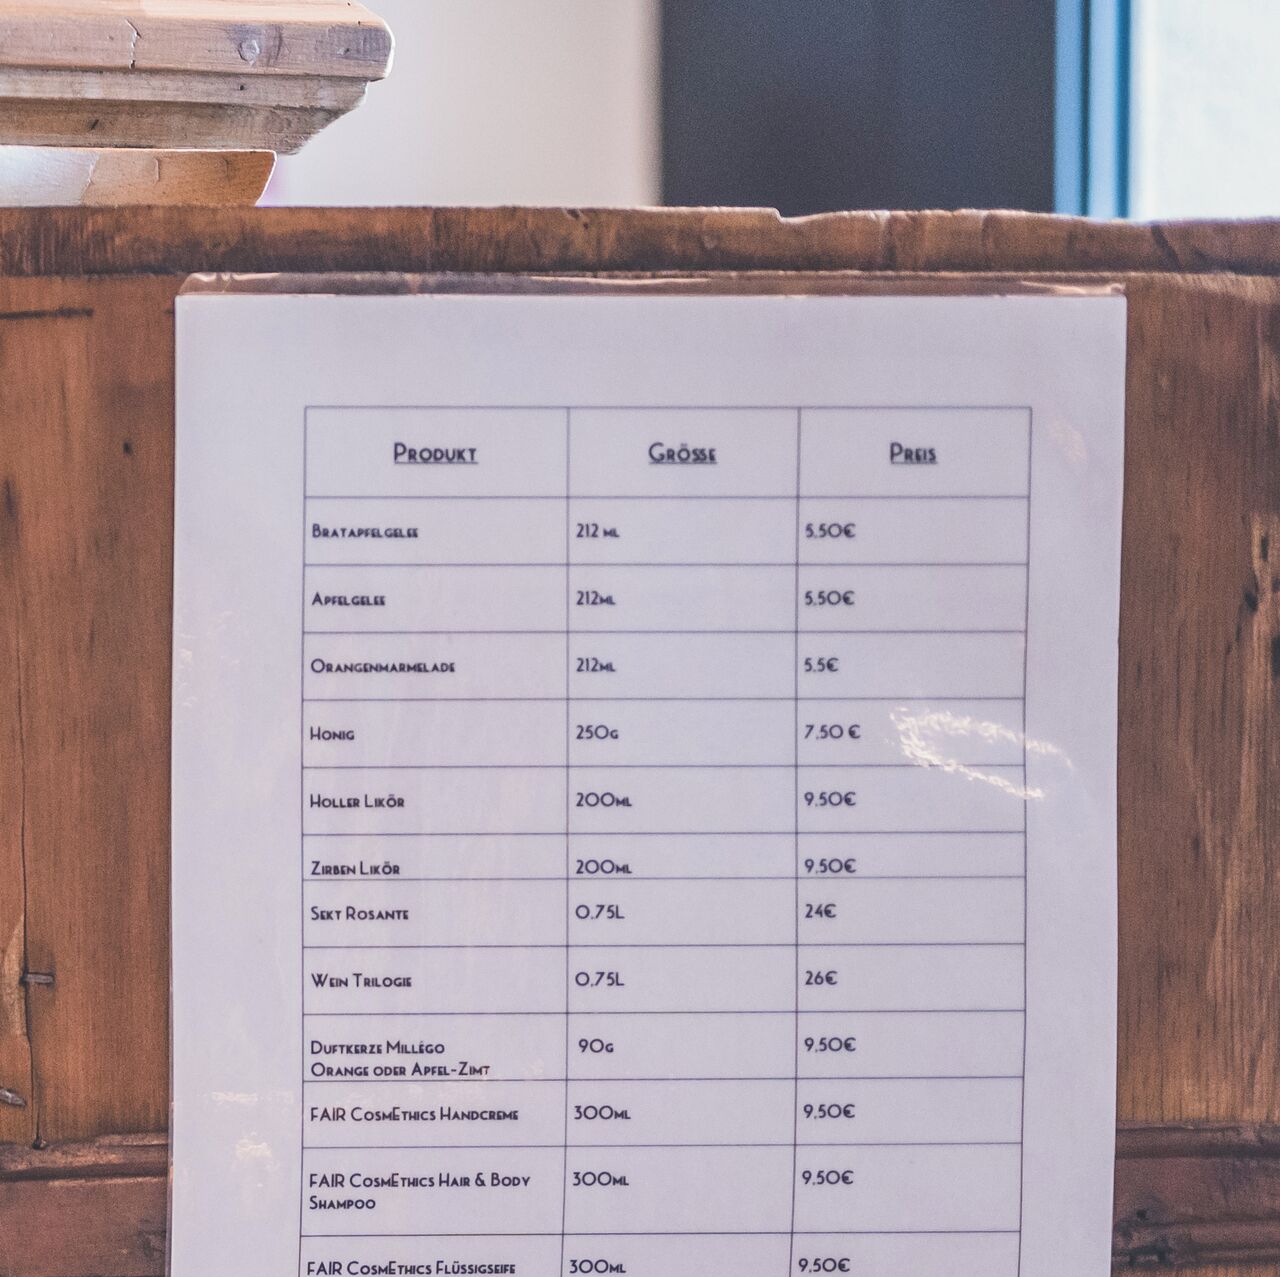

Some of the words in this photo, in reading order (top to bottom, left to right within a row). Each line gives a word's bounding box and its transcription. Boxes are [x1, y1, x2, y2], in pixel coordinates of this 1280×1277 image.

[575, 522, 600, 539] 212
[848, 723, 861, 740] €
[804, 902, 837, 919] 24€
[804, 969, 838, 986] 26€
[310, 1105, 347, 1122] FAIR
[309, 1171, 346, 1189] FAIR
[473, 1171, 487, 1189] &
[306, 1259, 343, 1277] FAIR
